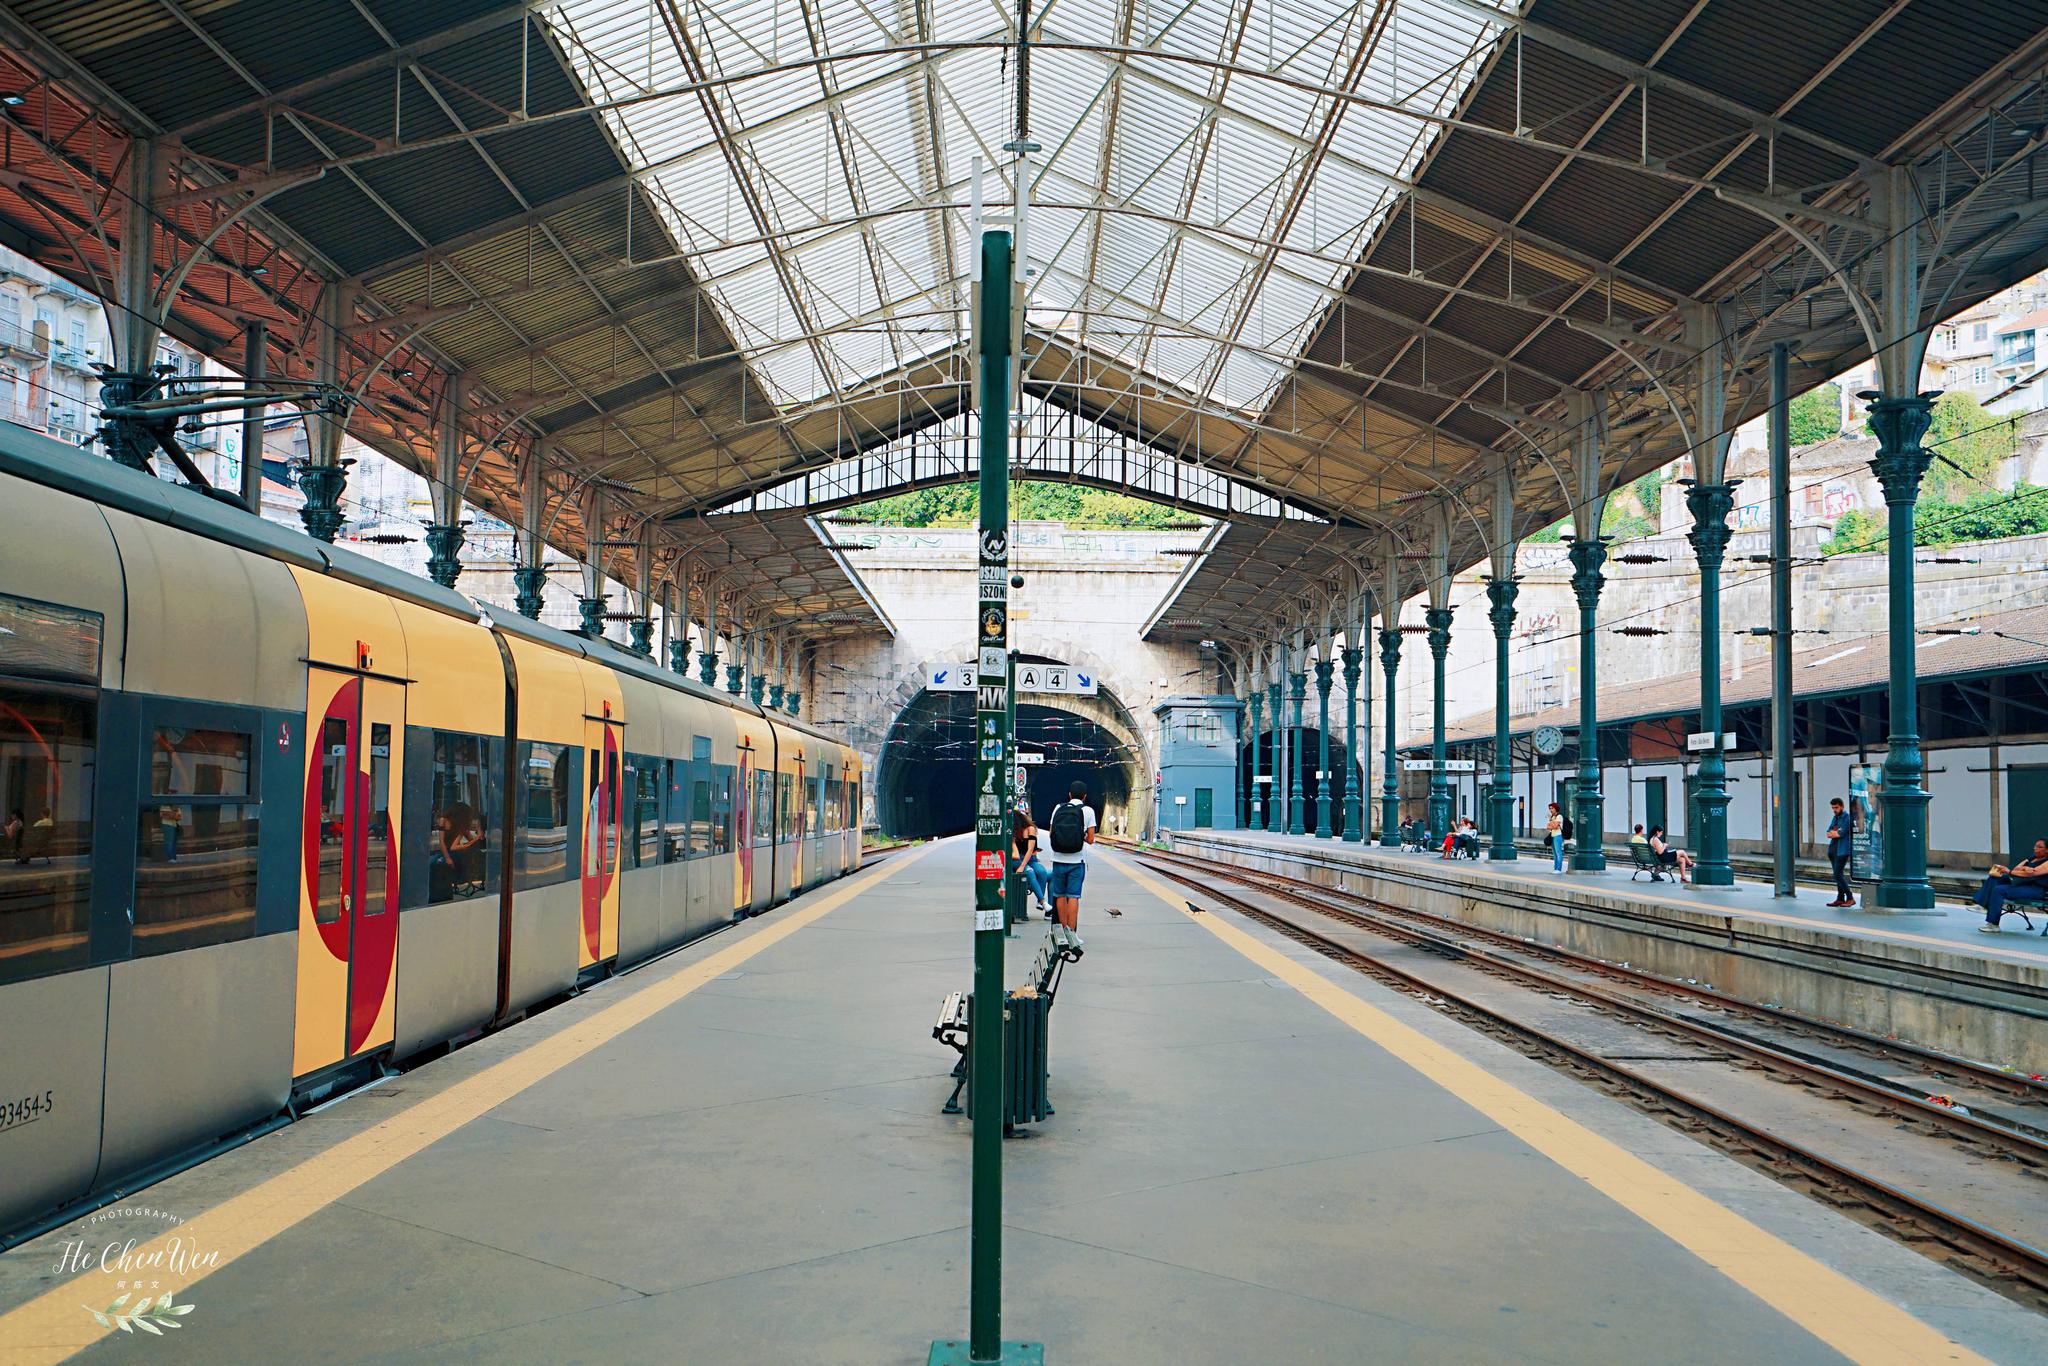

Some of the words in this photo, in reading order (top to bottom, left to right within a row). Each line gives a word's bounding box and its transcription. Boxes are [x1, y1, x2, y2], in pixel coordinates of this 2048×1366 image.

[963, 673, 972, 686] 3
[1023, 672, 1036, 685] A
[1051, 674, 1061, 687] 4
